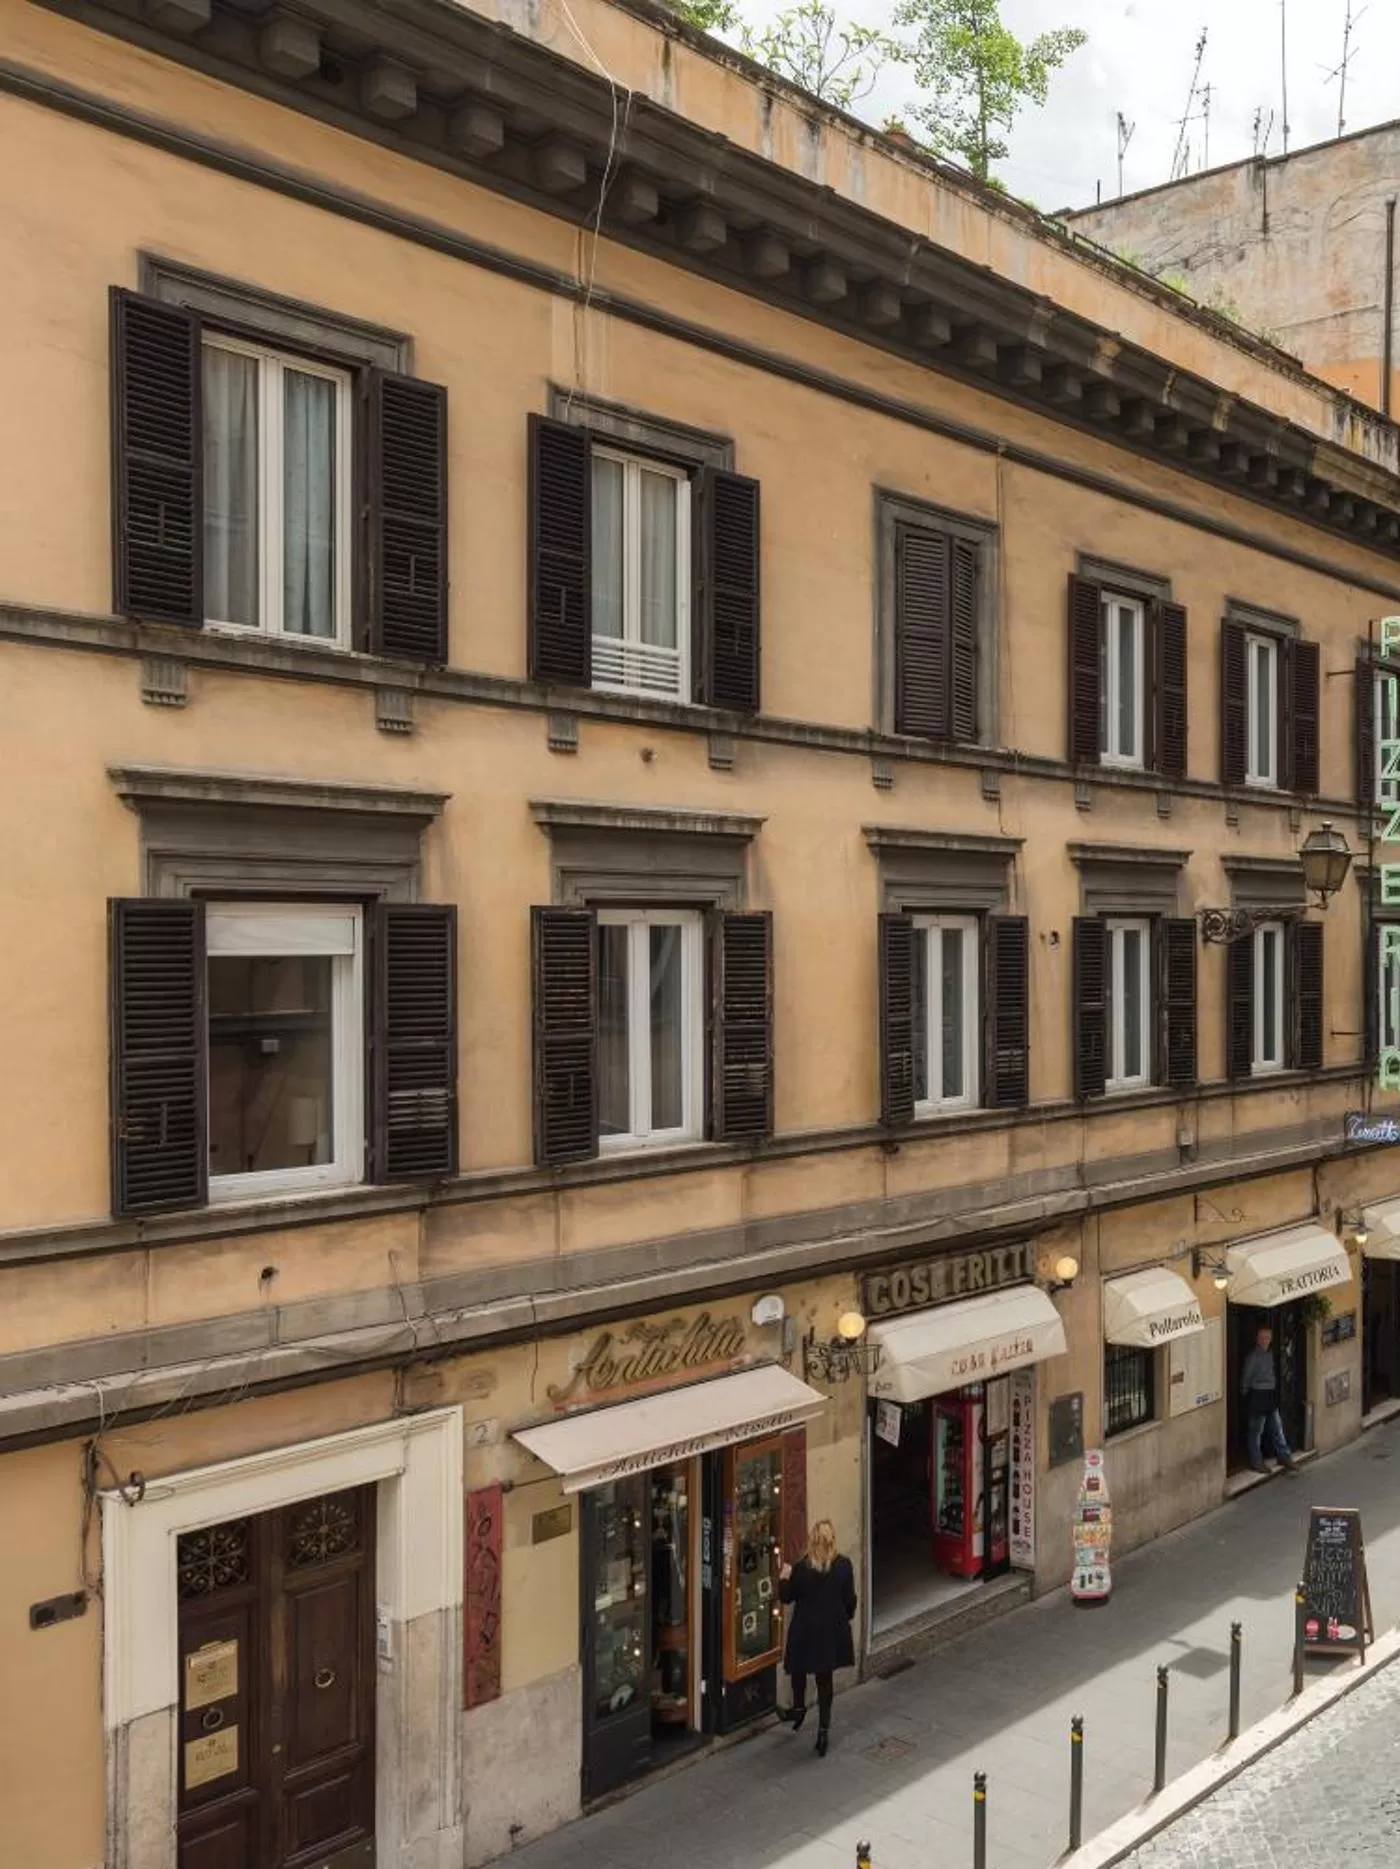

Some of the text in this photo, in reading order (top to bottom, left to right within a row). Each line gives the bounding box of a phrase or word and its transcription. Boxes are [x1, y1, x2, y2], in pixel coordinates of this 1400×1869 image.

[1278, 1265, 1340, 1295] TRATTORIA
[1023, 1395, 1033, 1462] PIZZA
[1022, 1469, 1033, 1539] HOUSE
